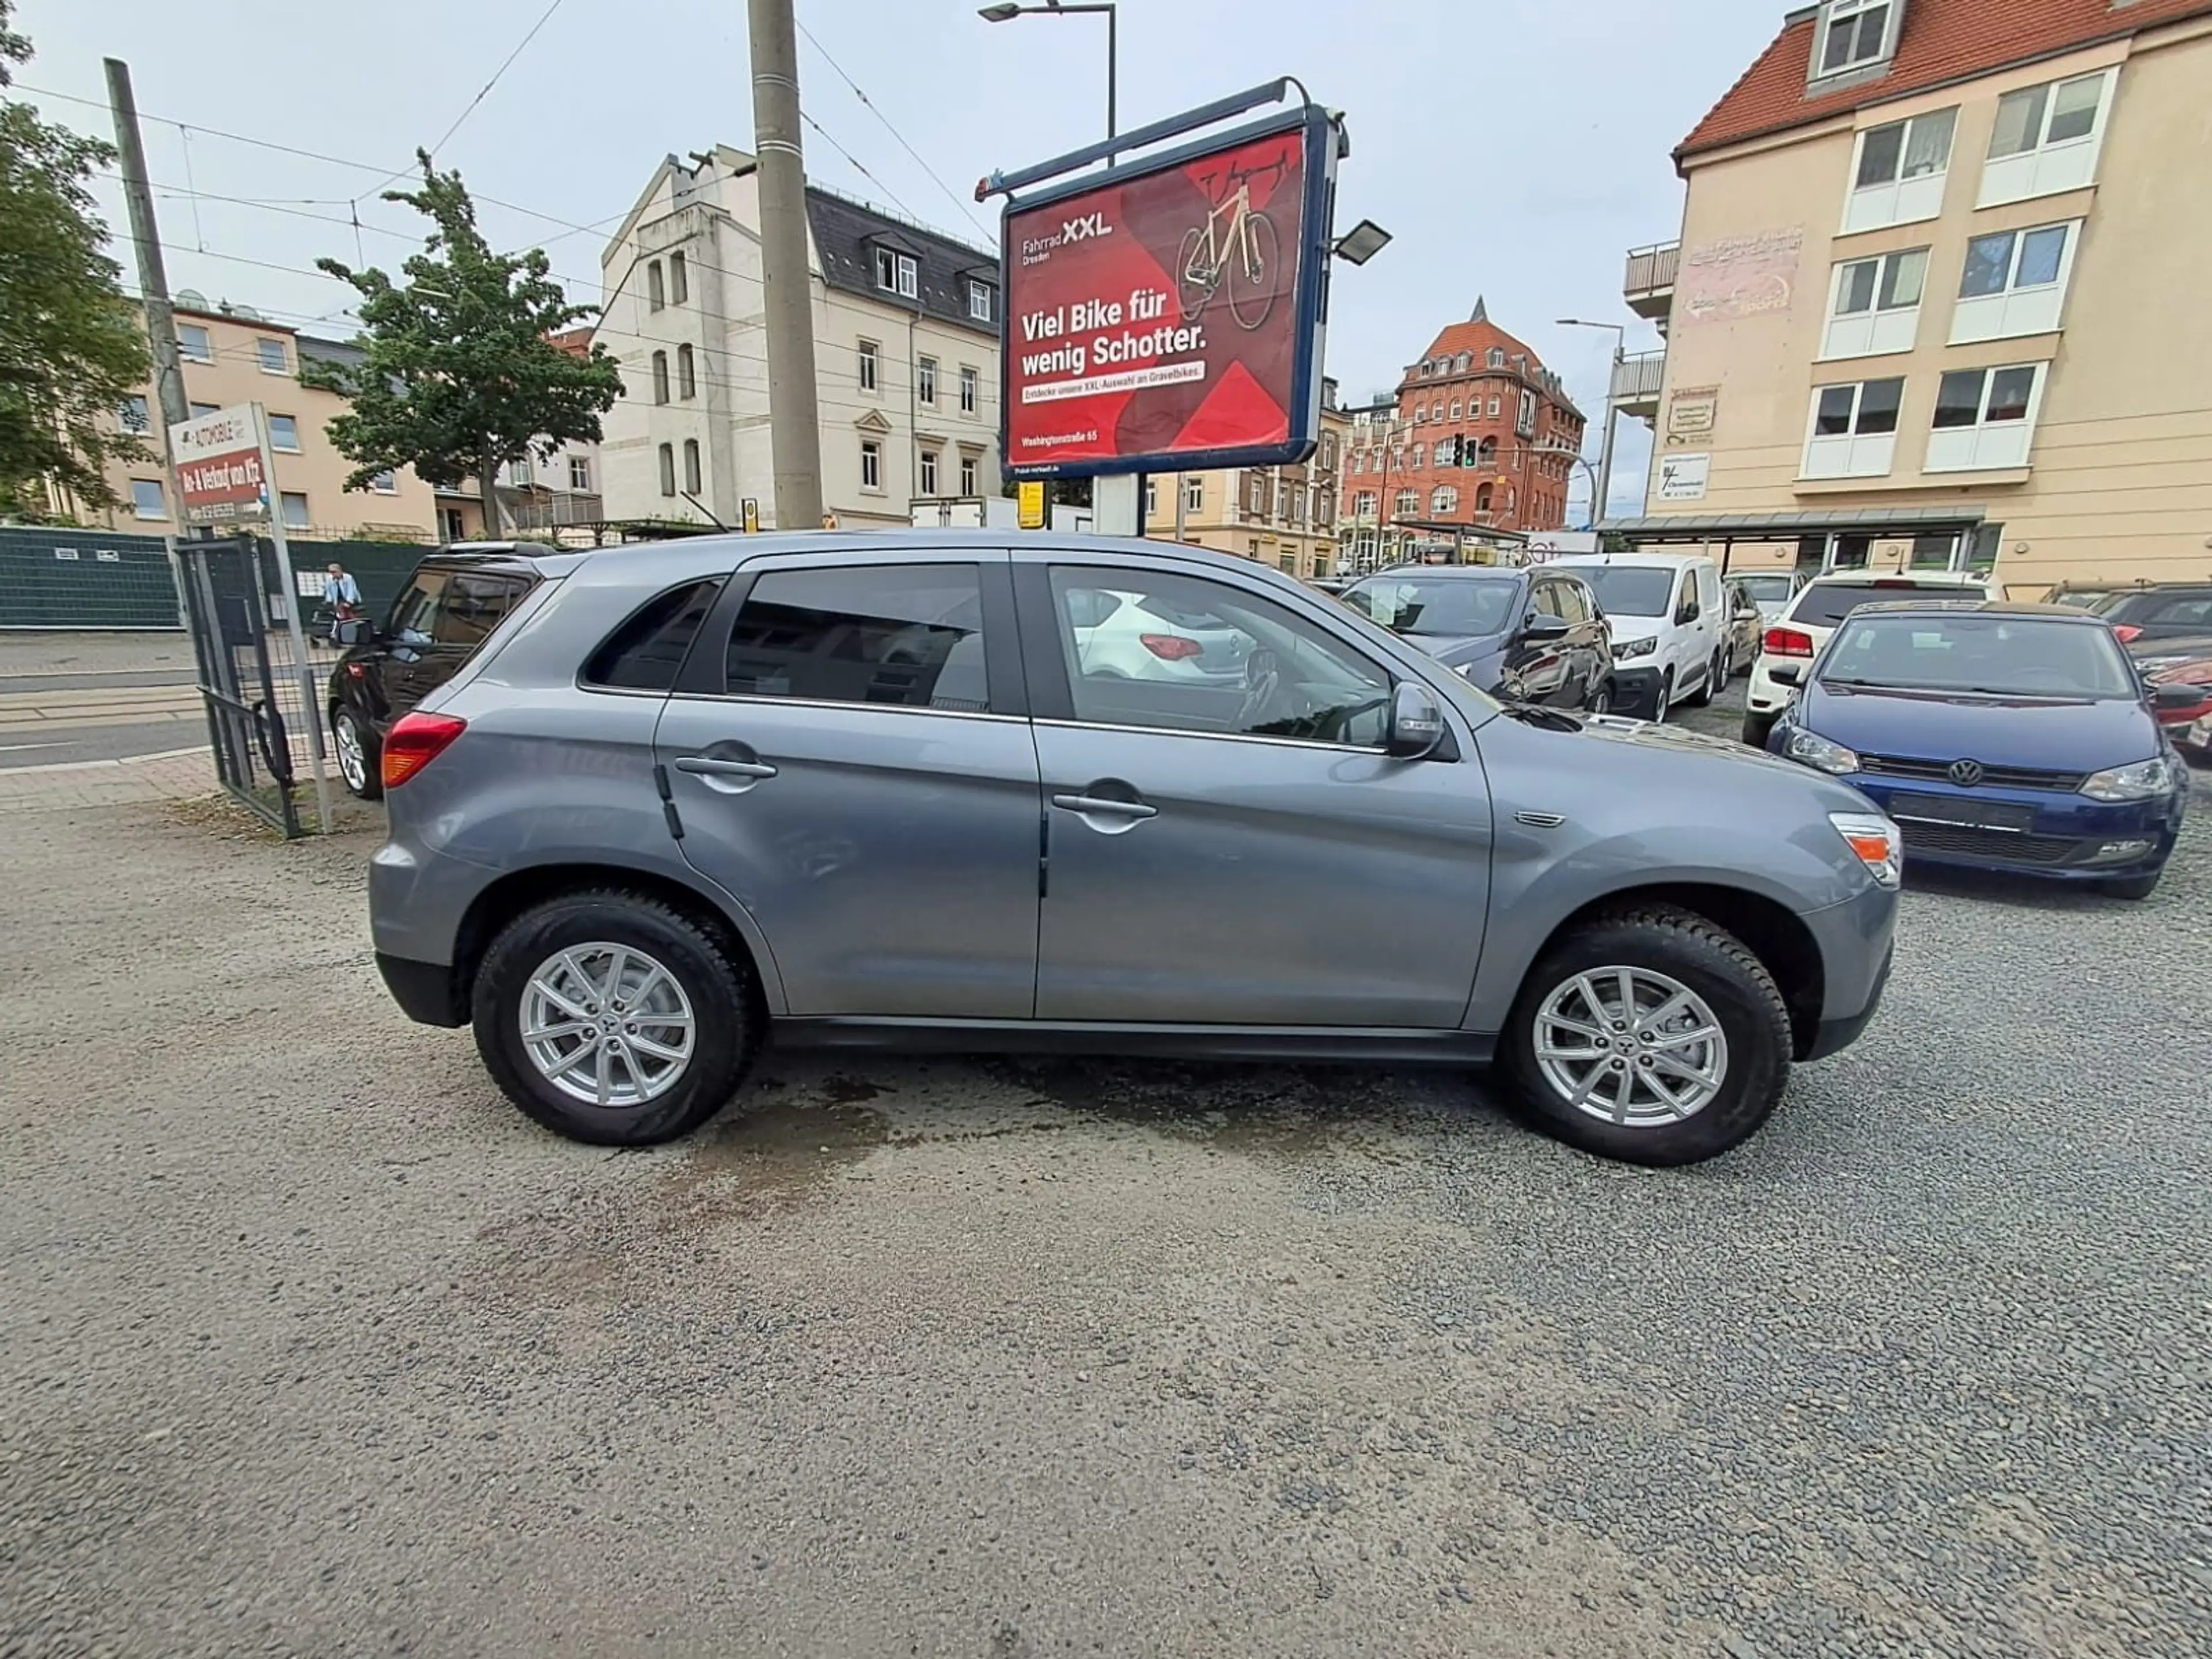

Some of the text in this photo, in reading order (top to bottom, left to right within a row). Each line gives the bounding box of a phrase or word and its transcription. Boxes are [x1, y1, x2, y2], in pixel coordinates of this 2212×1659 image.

[1023, 211, 1112, 254] Fahrrad XXL
[1023, 252, 1050, 266] Dresden
[1022, 289, 1166, 341] Viel Bike für
[1022, 325, 1206, 376] wenig Schotter.
[1025, 388, 1056, 399] Entdecke
[1137, 374, 1147, 384] an
